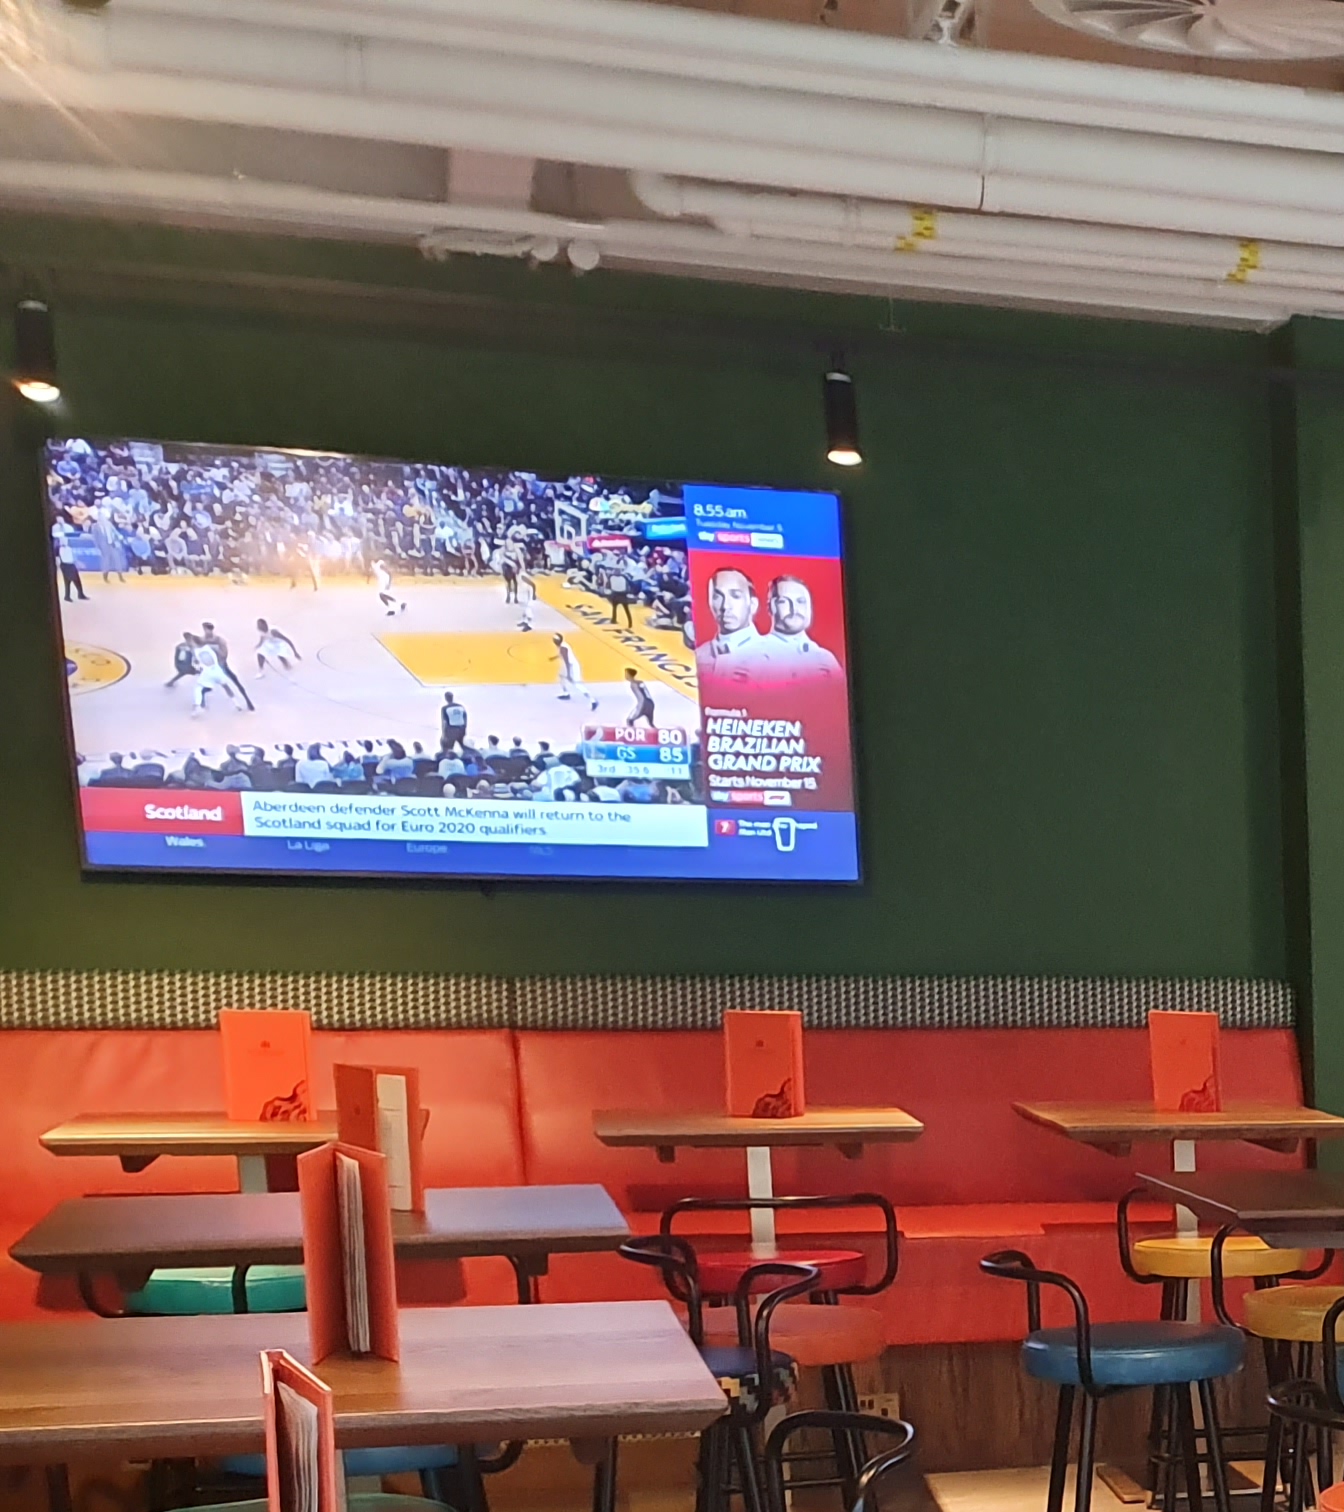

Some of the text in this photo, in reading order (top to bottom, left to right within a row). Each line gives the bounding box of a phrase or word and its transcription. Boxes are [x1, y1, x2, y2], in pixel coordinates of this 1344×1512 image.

[565, 603, 618, 625] SAN
[614, 727, 683, 745] POR 80
[706, 717, 802, 738] HEINEKEN
[616, 746, 684, 763] GS 85
[707, 735, 805, 755] BRAZILIAN
[708, 754, 822, 774] GRAND PRIX
[708, 774, 745, 788] Starts
[745, 775, 803, 789] November
[144, 803, 224, 822] Scotland
[252, 800, 632, 823] Aberdeen defender Scott McKenna will return to the
[254, 816, 547, 838] Scotland squad for Euro 2020 qualifiers
